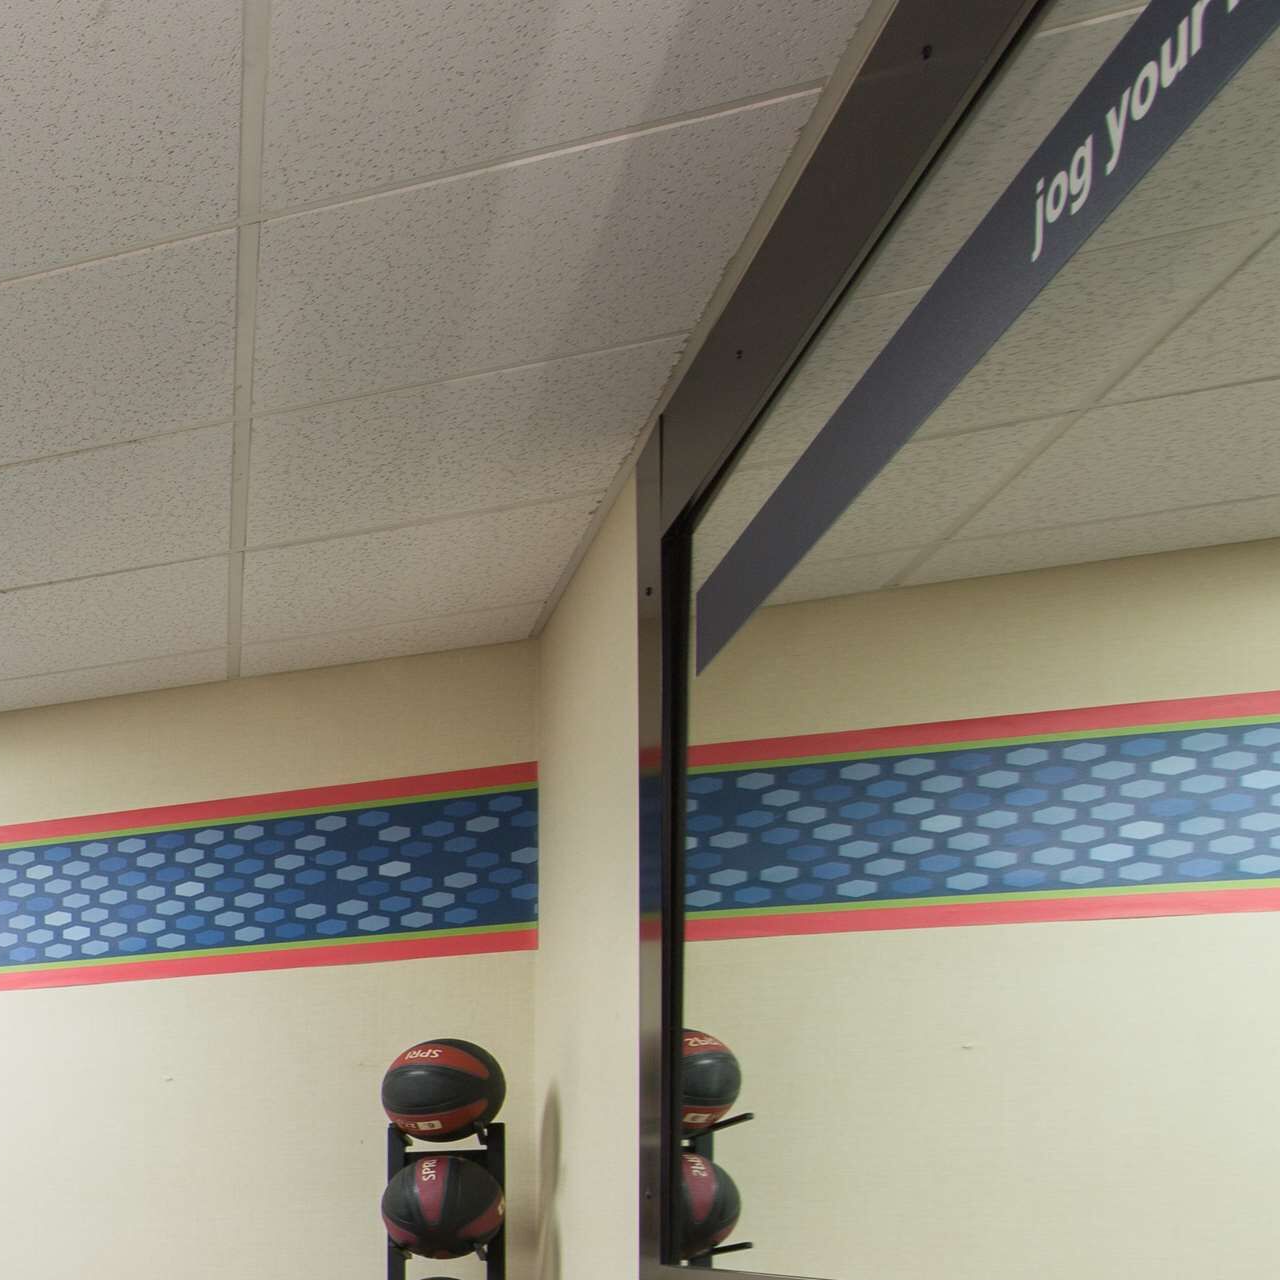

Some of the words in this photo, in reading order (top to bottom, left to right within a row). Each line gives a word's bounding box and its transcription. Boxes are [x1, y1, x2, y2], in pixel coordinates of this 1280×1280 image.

[1031, 177, 1094, 263] jog
[1105, 0, 1211, 176] your
[405, 1049, 443, 1060] SPRI
